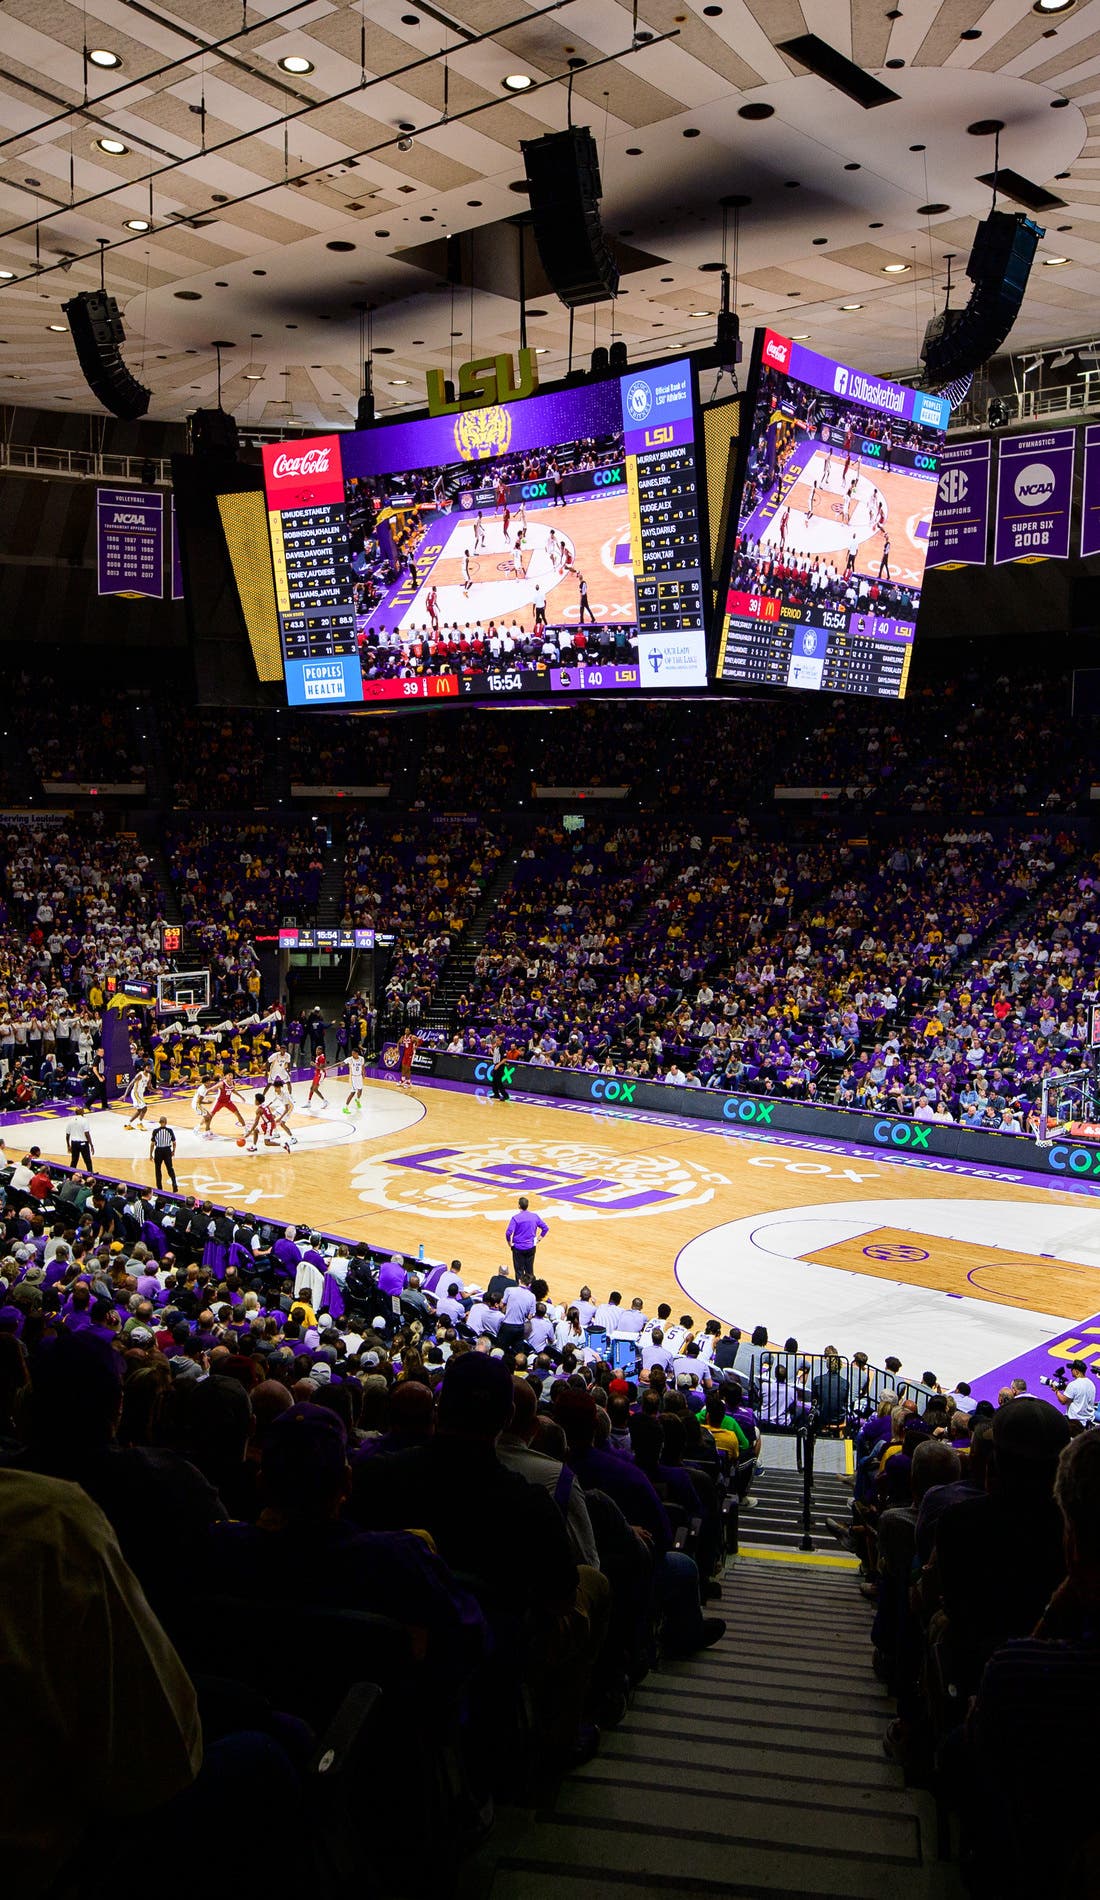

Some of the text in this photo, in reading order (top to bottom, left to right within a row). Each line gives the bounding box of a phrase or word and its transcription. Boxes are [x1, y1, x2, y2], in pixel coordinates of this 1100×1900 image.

[425, 347, 539, 417] LSU
[656, 380, 686, 395] Official Bank of
[666, 392, 687, 402] Athletics
[848, 374, 906, 414] LSUbasketball
[923, 400, 942, 412] PEOPLES
[645, 426, 674, 446] LSU
[862, 440, 880, 456] COX
[1018, 438, 1056, 449] GYMNASTICS
[637, 448, 686, 464] MURRAY,BRANDON
[942, 448, 972, 459] YMNASTICS
[272, 448, 332, 478] Coca-Cola
[661, 464, 666, 472] 0
[688, 458, 694, 466] 3
[914, 455, 936, 470] COX
[593, 468, 621, 486] COX
[638, 476, 671, 489] GAINES,ERIC
[522, 483, 548, 498] COX
[939, 469, 969, 504] SEC
[1018, 482, 1053, 497] NCAA
[282, 507, 331, 519] UMUDE,STANLEY
[640, 501, 672, 512] FUDGE,ALEX
[934, 506, 972, 517] CHAMPIONS
[113, 513, 146, 524] NCAA
[649, 510, 684, 524] 9 0 0
[284, 526, 340, 539] ROBINSON,KHALEN
[642, 524, 676, 537] DAYS,DARIUS
[1012, 520, 1054, 532] SUPER SIX
[327, 536, 332, 544] 0
[650, 534, 698, 548] 0 4 2 2
[1014, 532, 1050, 548] 2008
[286, 548, 333, 560] DAVIS,DAVONTE
[644, 550, 674, 561] EASON,TARI
[682, 558, 698, 568] 2 2
[290, 588, 340, 600] WILLIAMS,JAYLIN
[671, 585, 678, 593] 33
[348, 596, 352, 604] 2
[749, 598, 757, 612] 39
[650, 602, 679, 612] 17 10
[780, 606, 810, 622] PERIOD 2
[822, 611, 846, 628] 15:54
[290, 616, 353, 628] 43.8 20 88.9
[878, 622, 889, 634] 40
[326, 632, 330, 640] 4
[350, 630, 354, 638] 3
[895, 626, 912, 636] LSU
[306, 666, 342, 679] PEOPLES
[588, 672, 602, 685] 40
[615, 671, 637, 682] LSU
[403, 682, 418, 694] 39
[465, 682, 470, 690] 2
[488, 674, 522, 690] 15:54
[308, 684, 342, 694] HEALTH
[316, 931, 338, 939] 15:54
[165, 936, 179, 950] 23
[360, 938, 372, 946] 40
[590, 1080, 637, 1102] COX
[724, 1098, 775, 1124] COX
[873, 1120, 932, 1148] COX
[558, 1104, 700, 1128] MARAVICH
[704, 1126, 874, 1158] ASSEMBLY
[884, 1156, 1024, 1182] CENTER
[748, 1156, 880, 1183] COX
[382, 1148, 680, 1209] LSU
[166, 1175, 284, 1204] COX
[668, 1330, 678, 1340] 5
